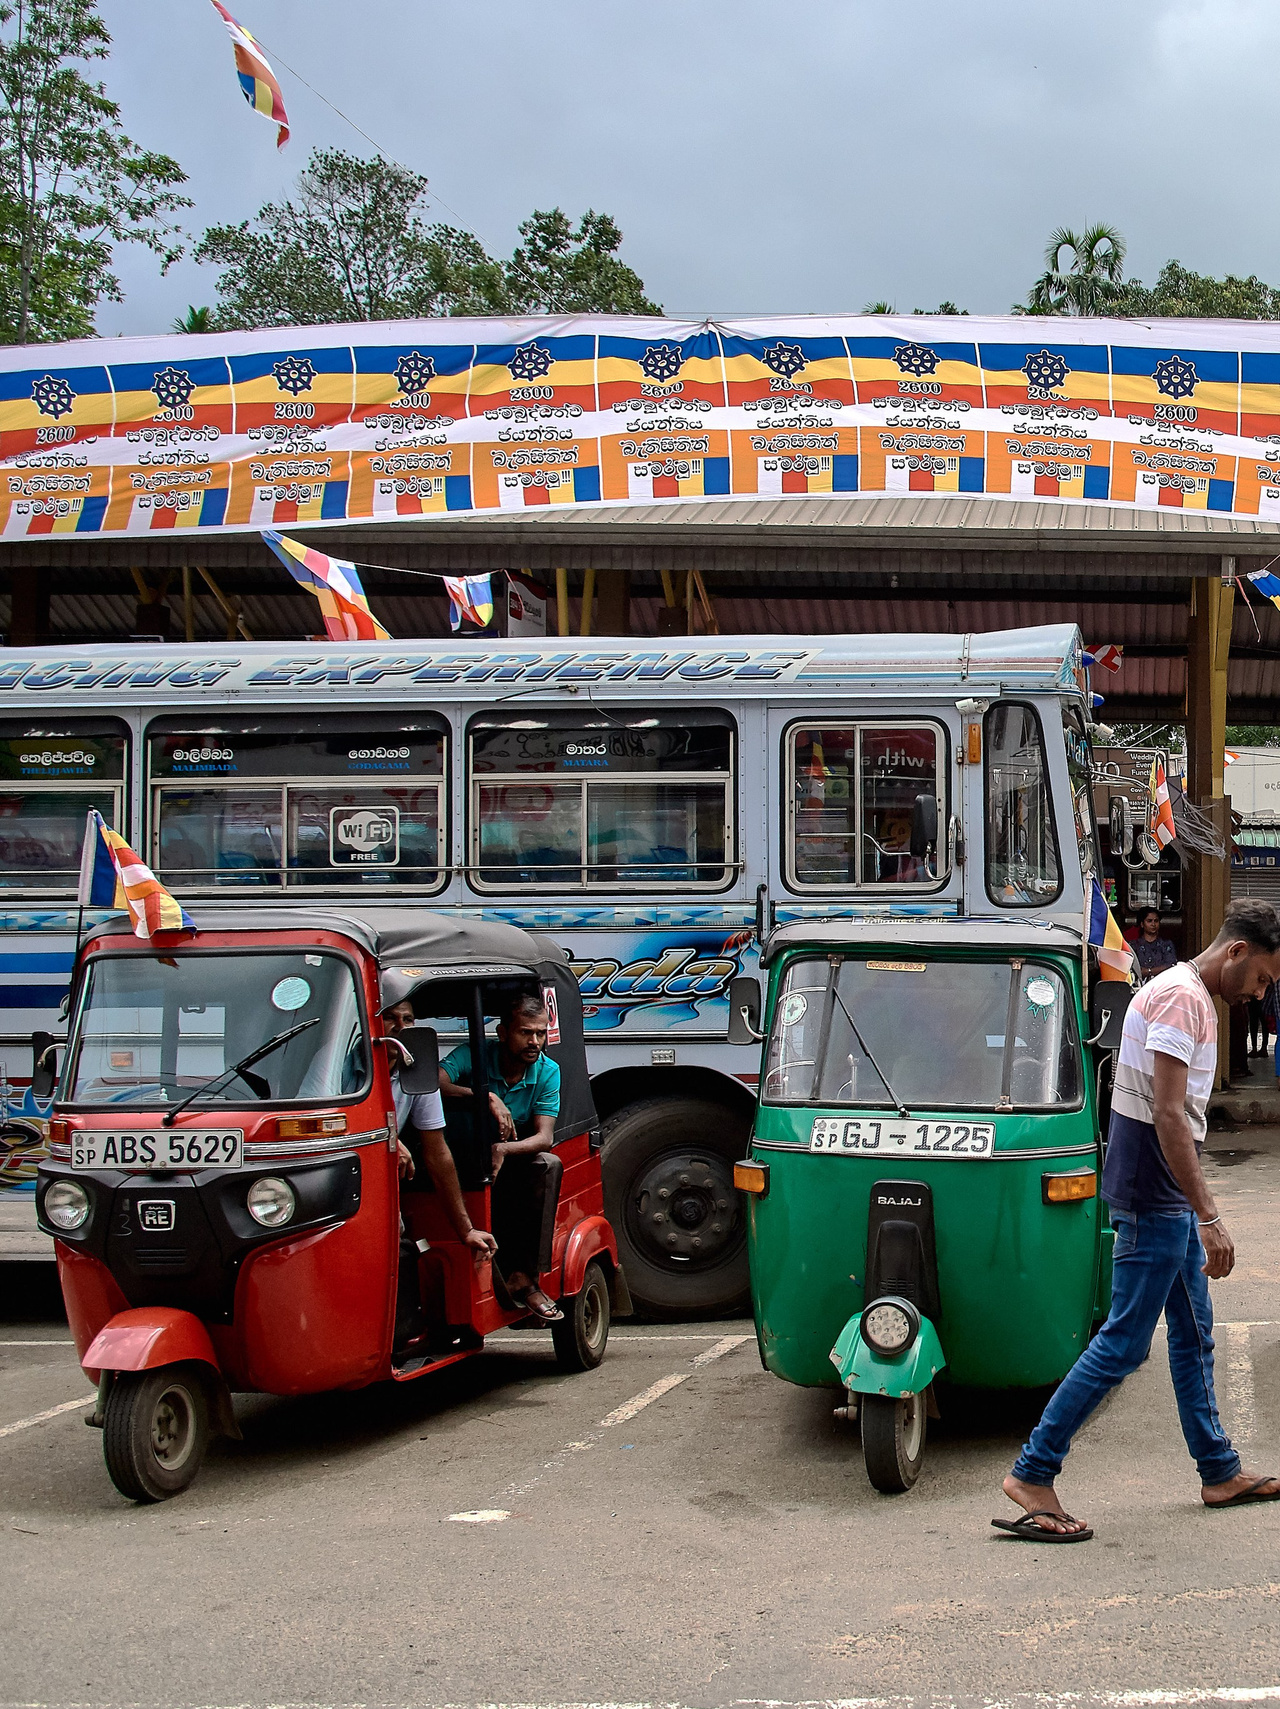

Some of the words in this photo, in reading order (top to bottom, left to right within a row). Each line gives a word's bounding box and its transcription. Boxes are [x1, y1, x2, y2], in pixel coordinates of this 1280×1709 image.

[510, 385, 554, 401] 2600
[899, 380, 941, 394] 2600
[275, 403, 314, 418] 2600
[1155, 405, 1199, 422] 2600
[37, 426, 75, 443] 2600
[246, 650, 810, 685] EXPERIENCE
[348, 747, 411, 760] ගොඩගම
[566, 743, 607, 756] මාතර
[172, 763, 238, 772] MALIMBADA
[347, 762, 410, 771] GODAGAMA
[563, 759, 609, 767] MATARA
[342, 823, 390, 839] WiFi
[350, 853, 378, 861] FREE
[841, 1121, 882, 1149] GJ
[913, 1124, 989, 1153] 1225
[74, 1149, 97, 1165] SP
[102, 1135, 156, 1165] ABS
[168, 1134, 238, 1164] 5629
[877, 1196, 922, 1206] BAJAJ
[144, 1210, 169, 1225] RE
